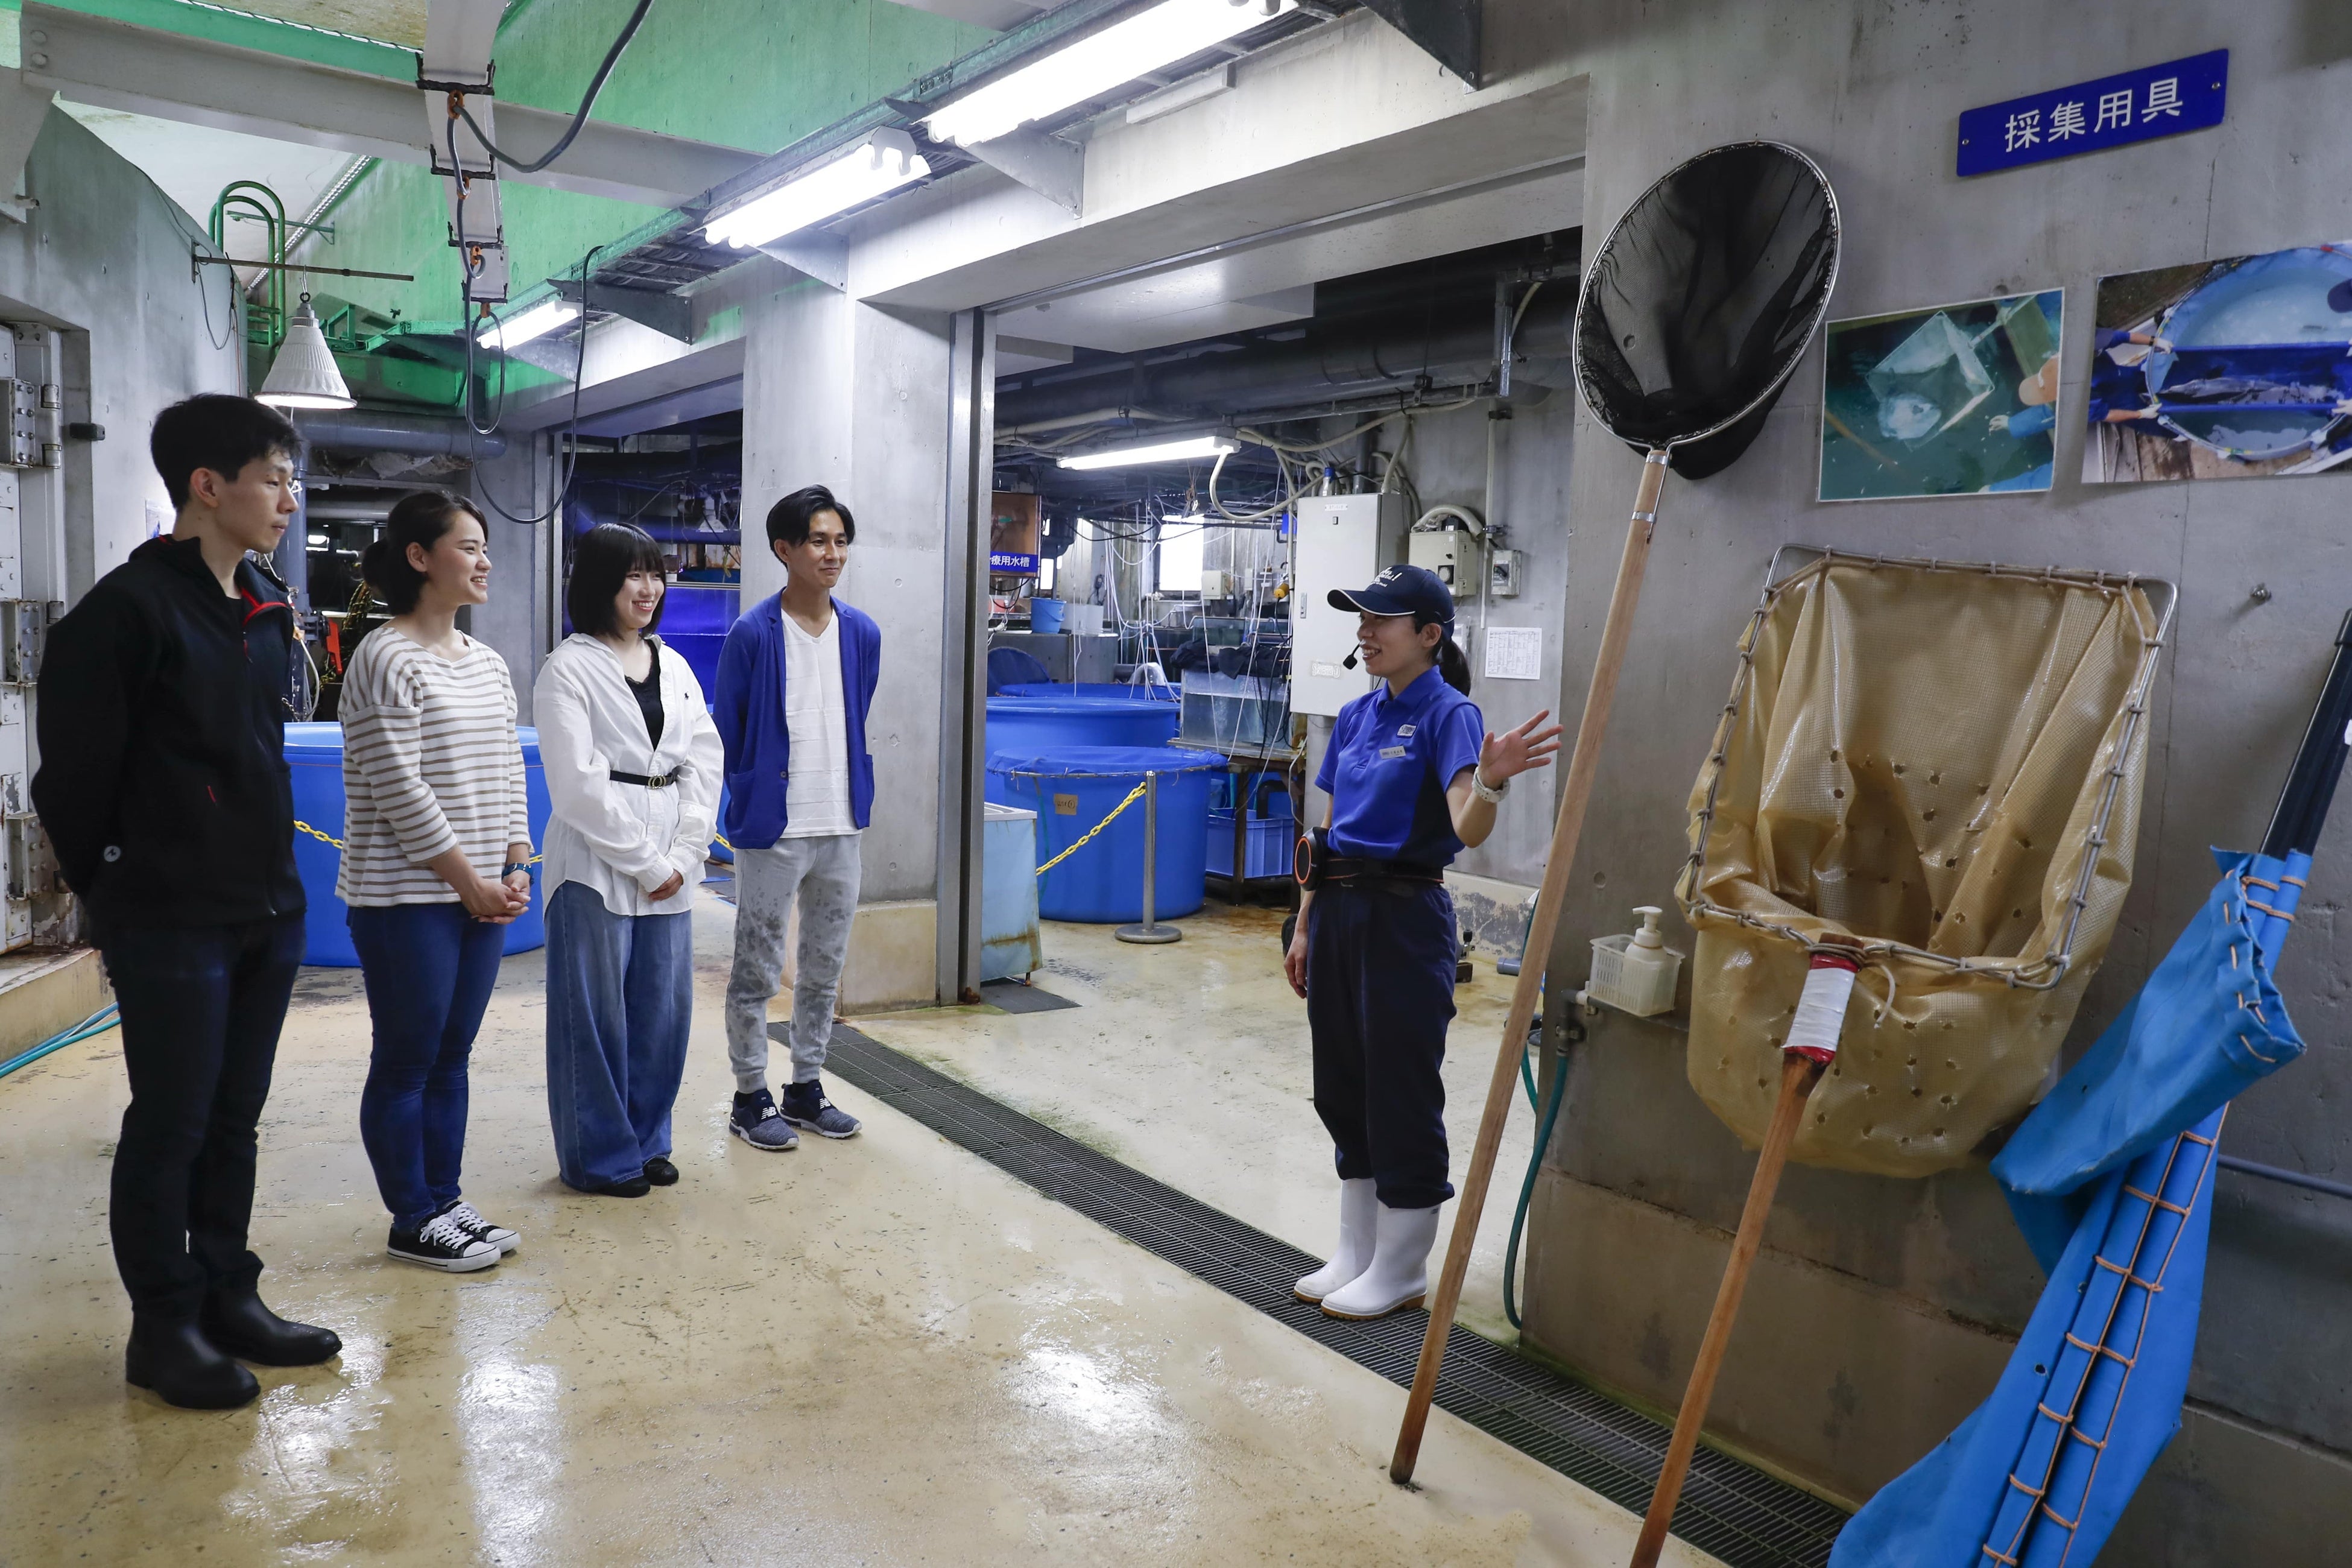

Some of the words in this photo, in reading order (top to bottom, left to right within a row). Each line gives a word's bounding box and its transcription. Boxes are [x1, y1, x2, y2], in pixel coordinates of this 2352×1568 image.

[2005, 77, 2183, 153] 採集用具
[990, 554, 1030, 567] 療用水槽
